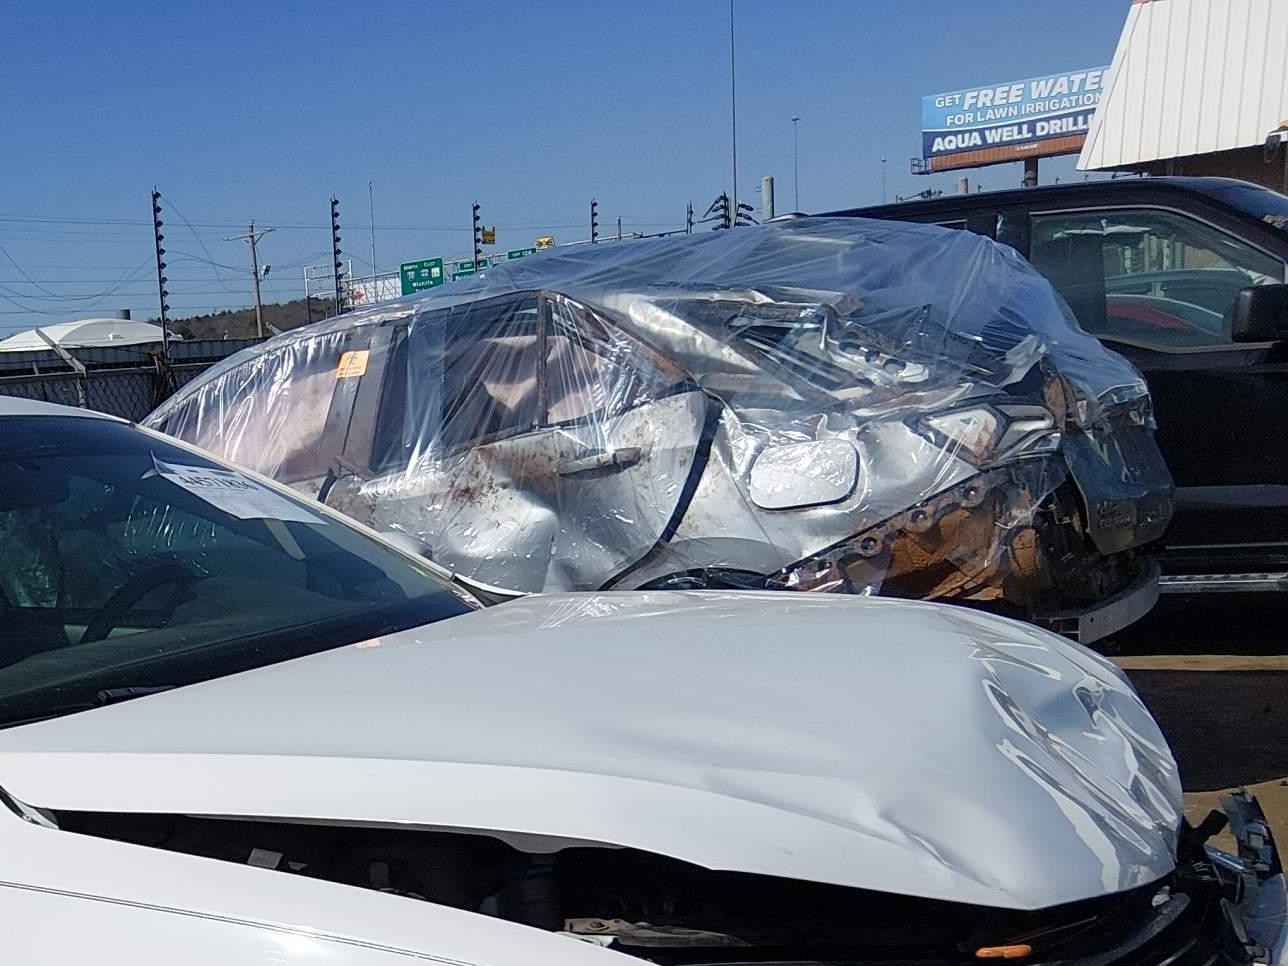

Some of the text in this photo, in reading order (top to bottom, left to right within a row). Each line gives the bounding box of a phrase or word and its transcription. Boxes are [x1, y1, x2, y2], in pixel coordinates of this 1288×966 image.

[935, 95, 961, 108] GET
[963, 84, 1024, 110] FREE
[946, 113, 974, 127] FOR
[978, 105, 1018, 122] LAWN
[932, 132, 982, 152] AQUA
[985, 122, 1032, 143] WELL
